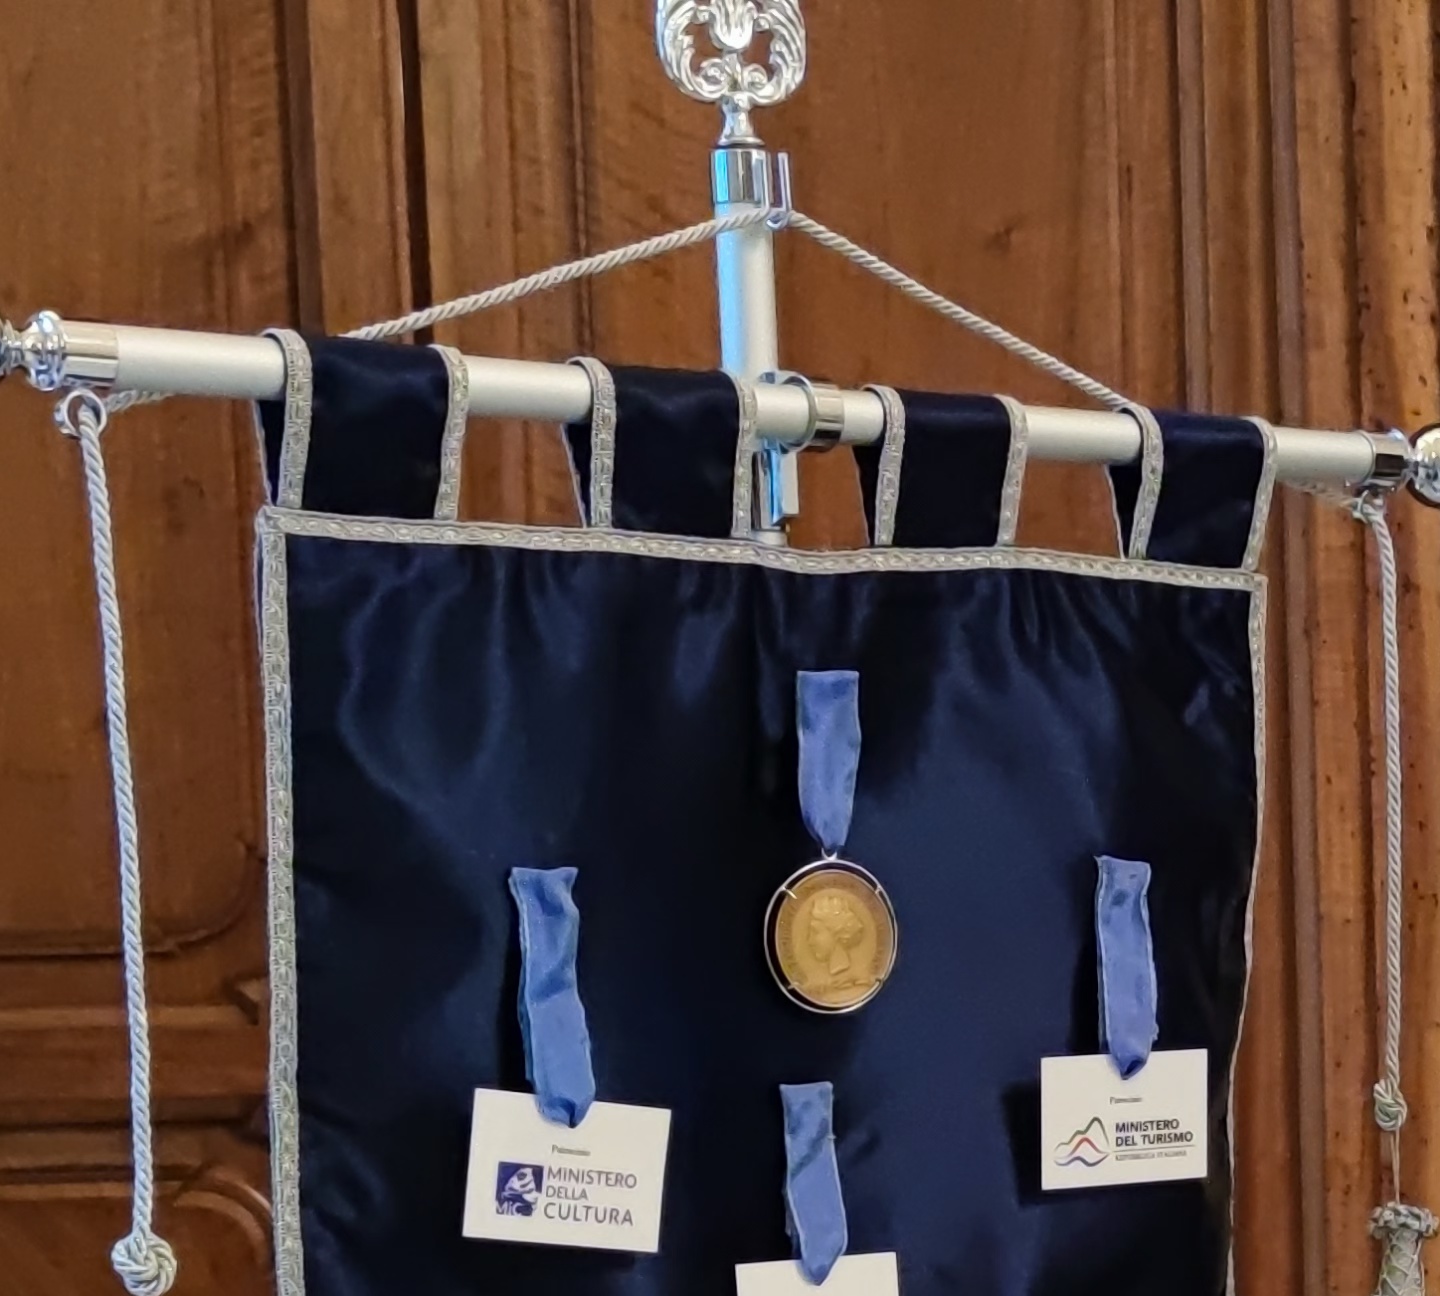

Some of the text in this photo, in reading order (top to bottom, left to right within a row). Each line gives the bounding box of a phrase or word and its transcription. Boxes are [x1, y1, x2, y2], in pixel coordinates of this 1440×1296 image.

[1115, 1118, 1180, 1134] MINISTERO
[1115, 1131, 1194, 1148] DEL TURISMO
[547, 1165, 638, 1189] MINISTERO
[545, 1185, 589, 1201] DELLA
[543, 1202, 634, 1226] CULTURA
